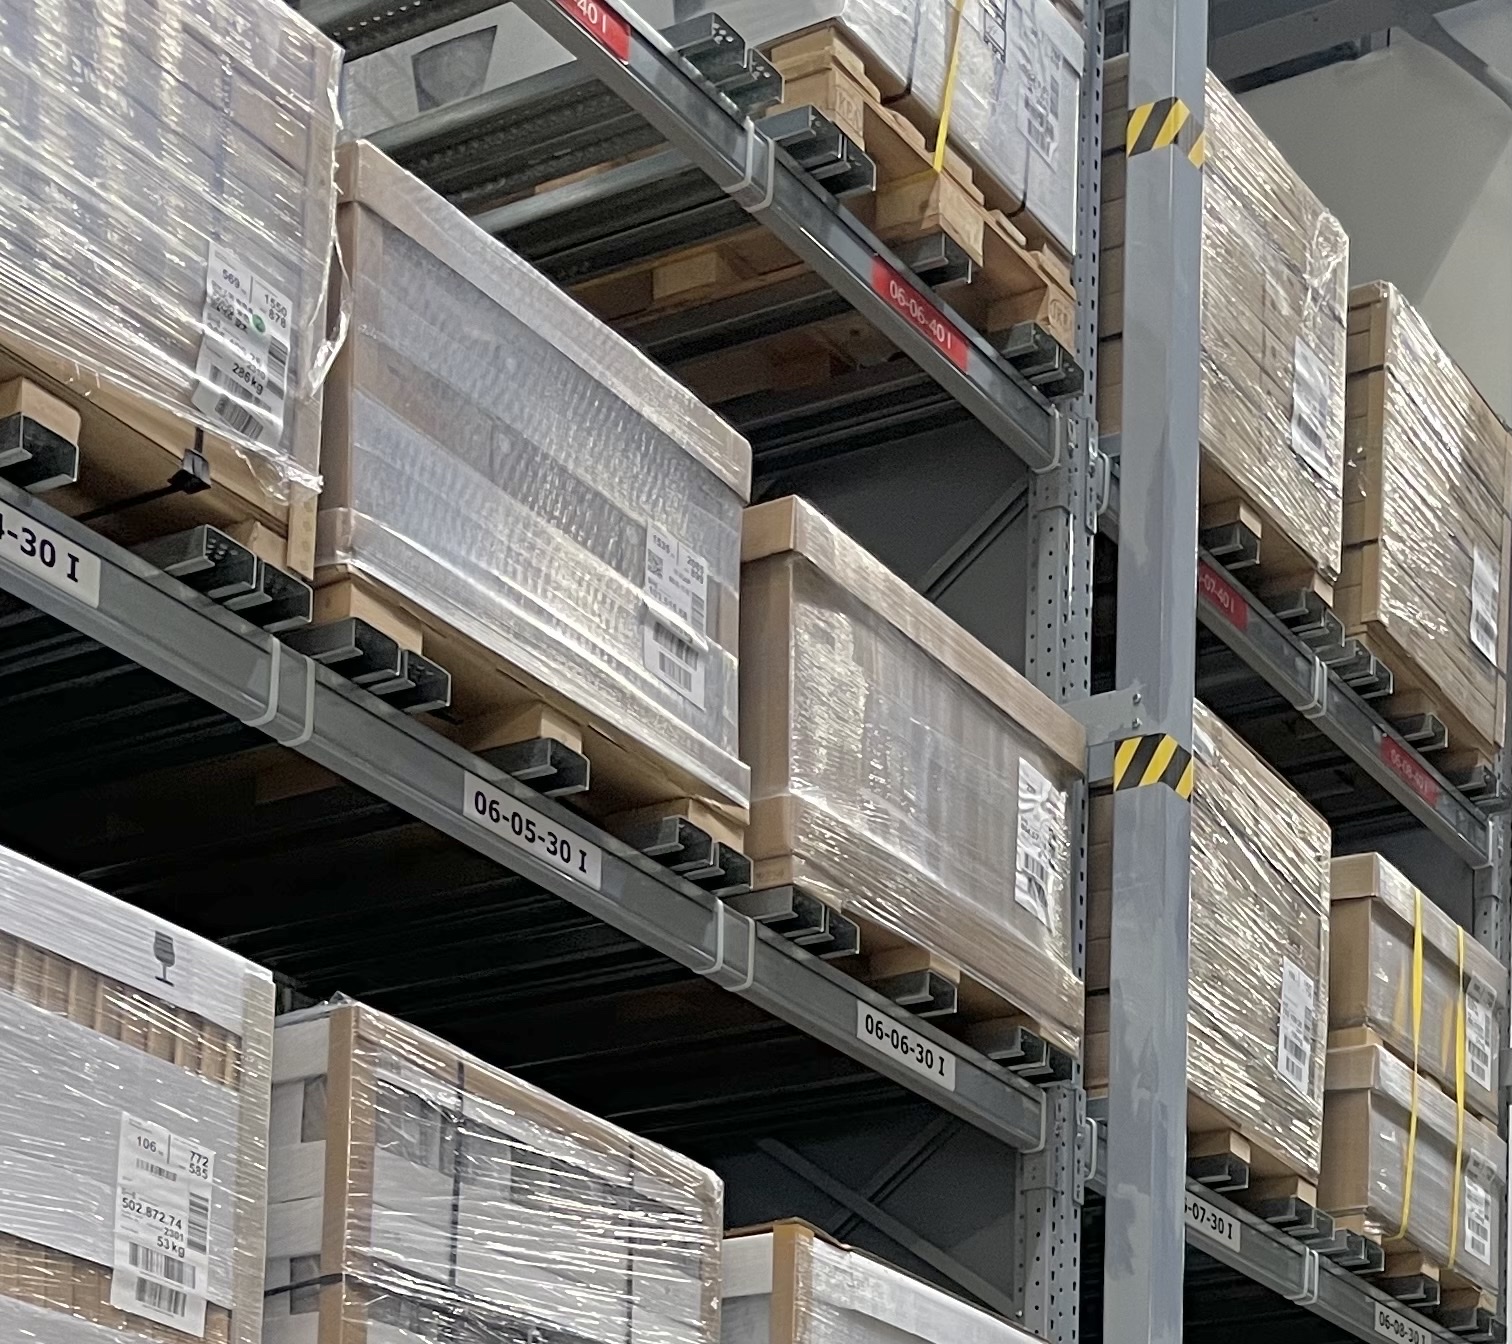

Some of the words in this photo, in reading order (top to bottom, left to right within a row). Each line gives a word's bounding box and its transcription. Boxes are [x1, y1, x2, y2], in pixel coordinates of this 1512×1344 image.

[889, 280, 945, 343] 06-06-40
[474, 790, 571, 864] 06-05-30
[865, 1014, 934, 1069] 06-06-30
[137, 1135, 157, 1153] 106
[190, 1150, 209, 1168] 772
